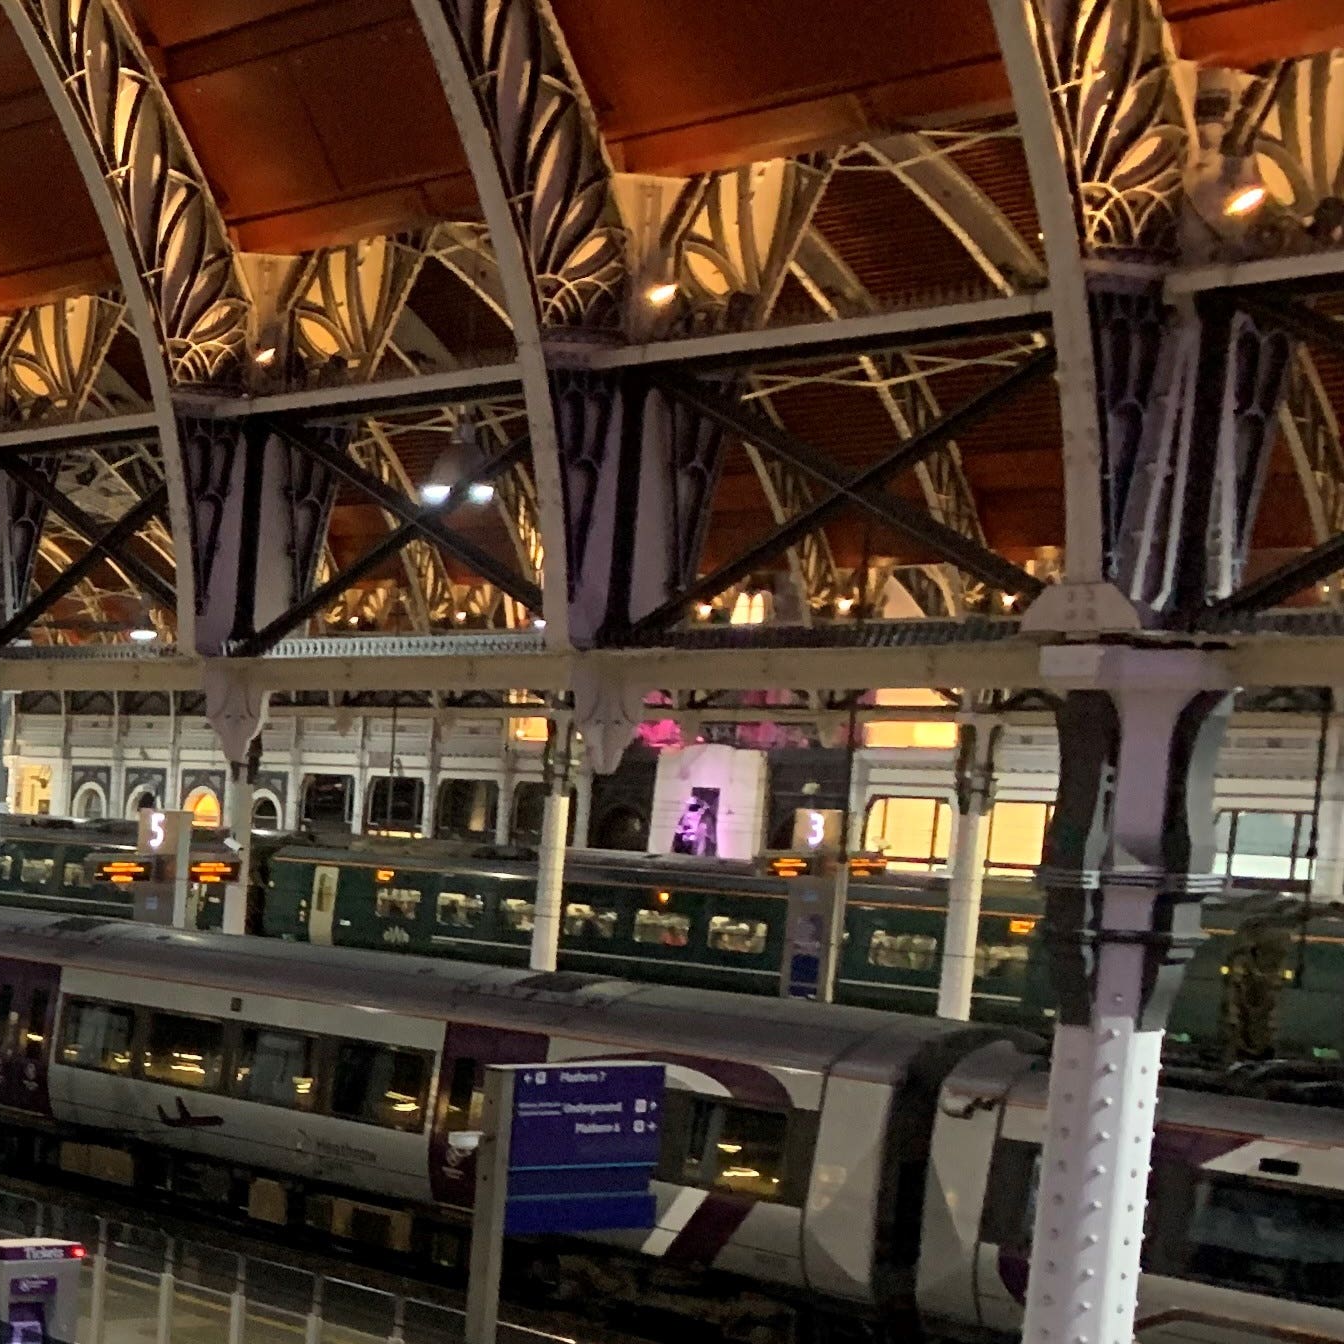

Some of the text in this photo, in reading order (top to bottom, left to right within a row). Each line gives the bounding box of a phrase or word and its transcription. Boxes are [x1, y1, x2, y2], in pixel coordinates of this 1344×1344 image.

[149, 812, 166, 847] 5
[807, 812, 825, 845] 3
[23, 1245, 65, 1260] Tickets
